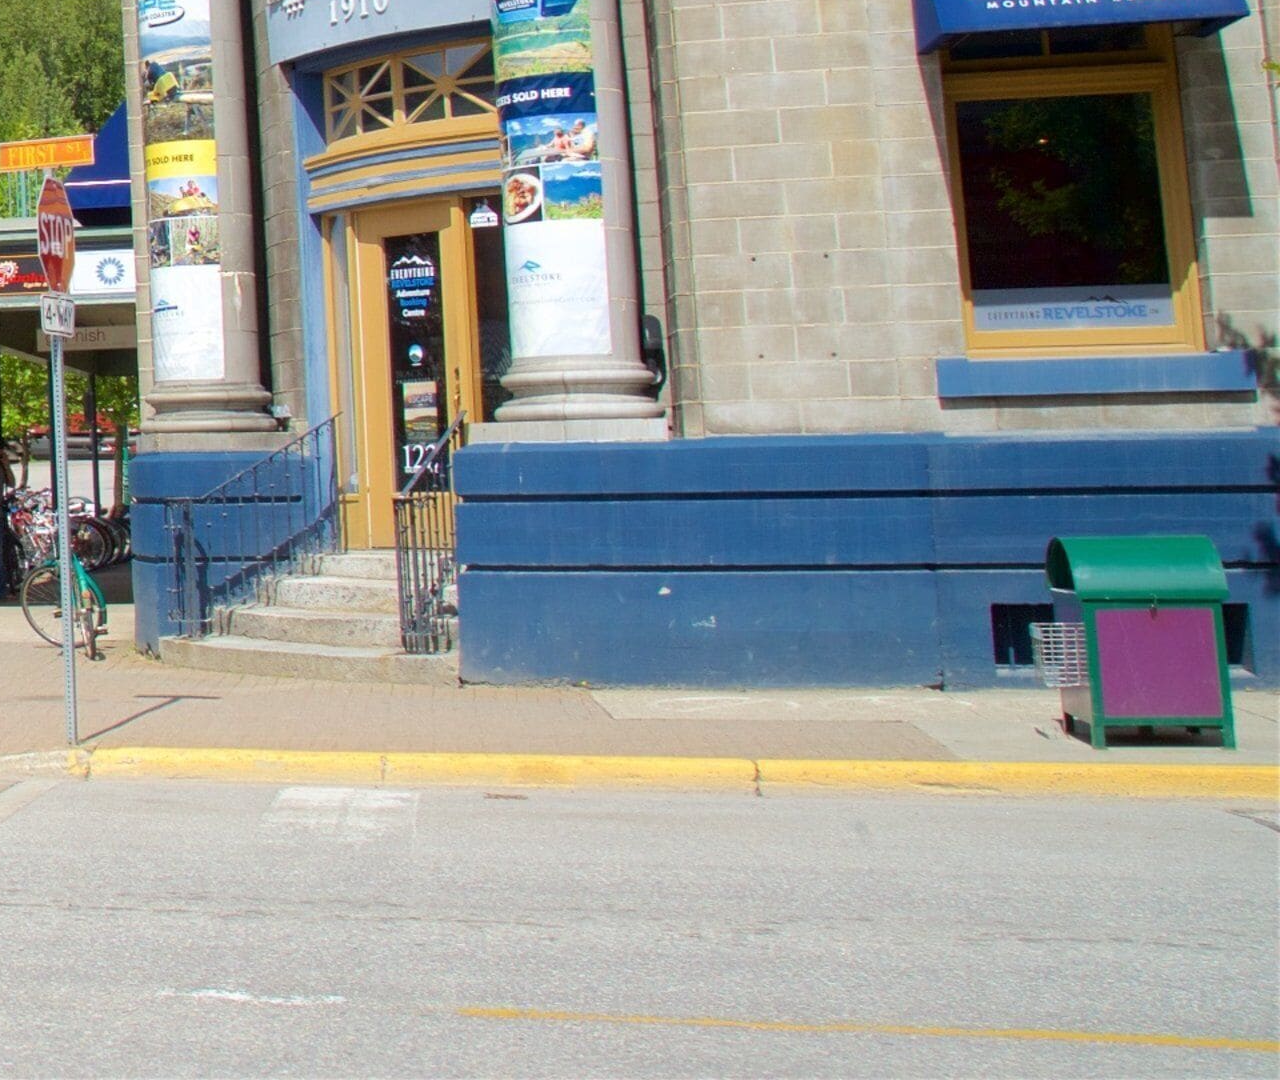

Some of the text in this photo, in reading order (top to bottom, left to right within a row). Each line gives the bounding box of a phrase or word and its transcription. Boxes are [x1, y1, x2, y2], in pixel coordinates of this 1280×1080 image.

[512, 89, 539, 103] SOLD
[541, 86, 572, 99] HERE
[8, 143, 57, 167] FIRST
[66, 141, 81, 153] ST
[152, 155, 169, 166] SOLD
[172, 153, 195, 163] HERE
[40, 211, 73, 259] STOP
[389, 266, 435, 280] EVERYTHING
[1041, 304, 1149, 321] REVELSTOKE
